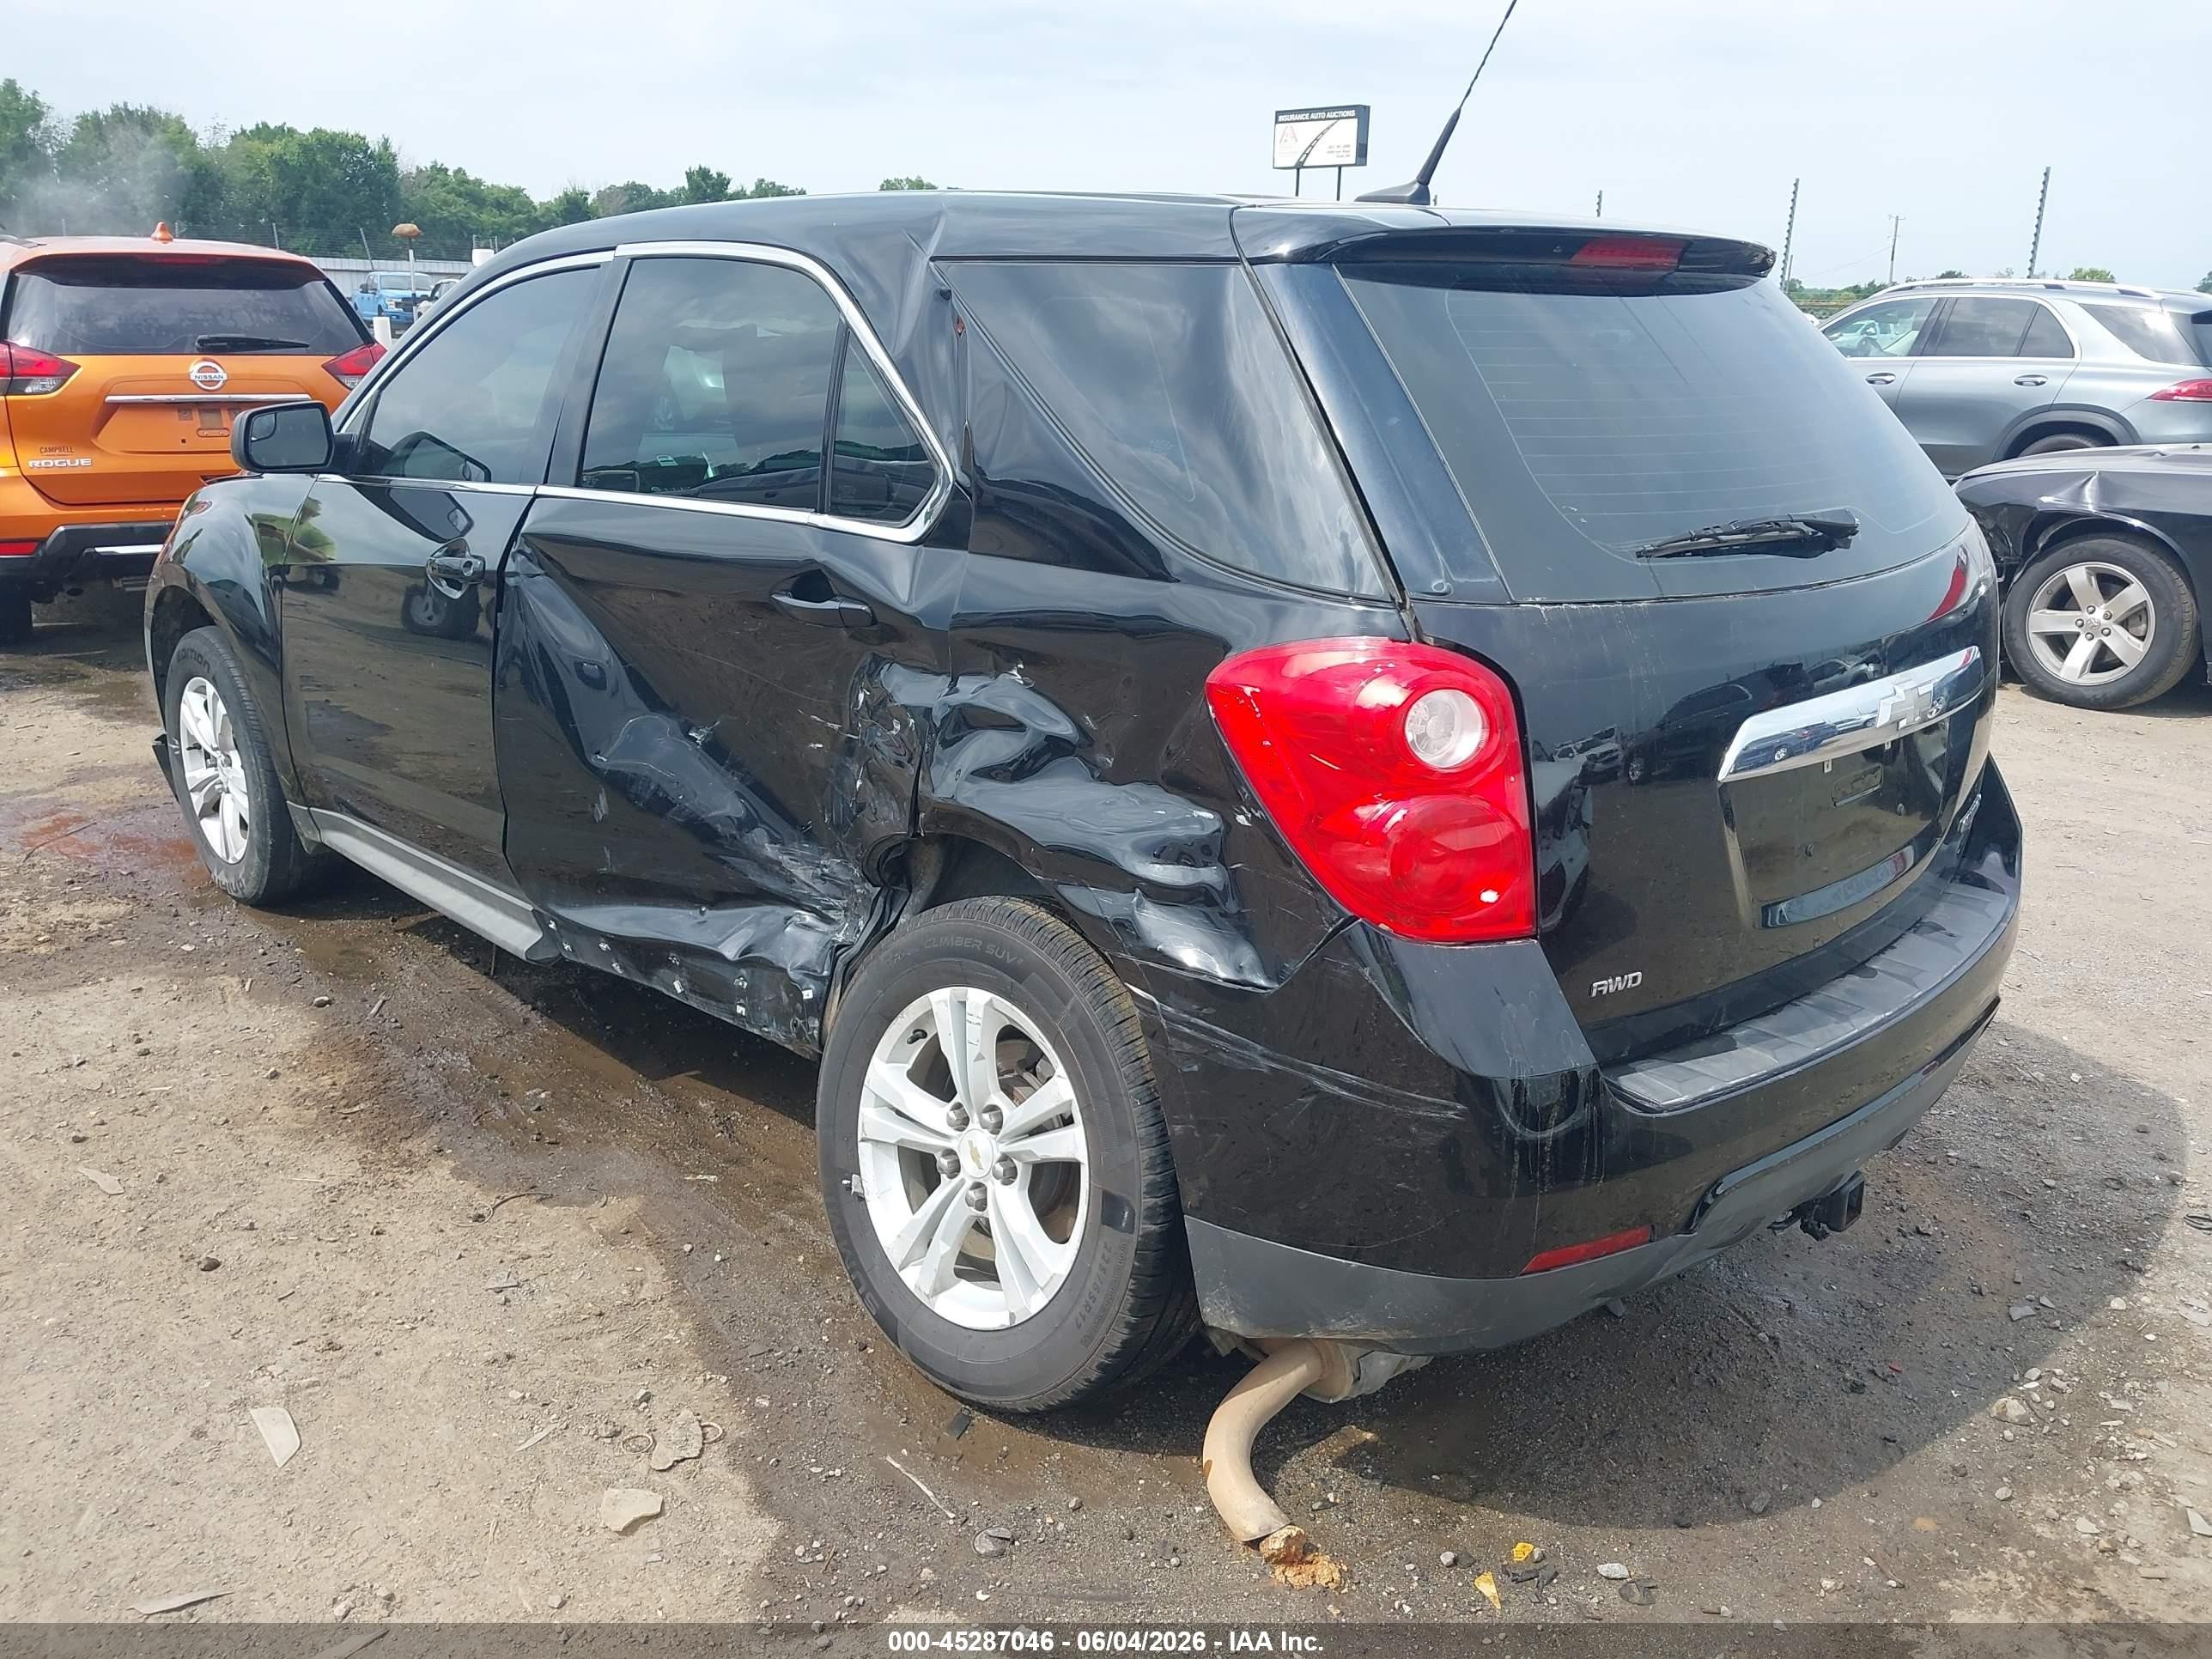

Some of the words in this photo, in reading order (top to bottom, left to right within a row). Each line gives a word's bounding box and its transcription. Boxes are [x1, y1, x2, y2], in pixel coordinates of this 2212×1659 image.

[1279, 112, 1310, 123] INSURANCE
[1326, 109, 1356, 118] AUCTIONS
[40, 446, 74, 454] CAMPBELL
[27, 458, 92, 468] ROGUE
[924, 936, 983, 951] CLIMBER
[1589, 971, 1643, 998] AWD
[1074, 1241, 1113, 1329] 225/65R17
